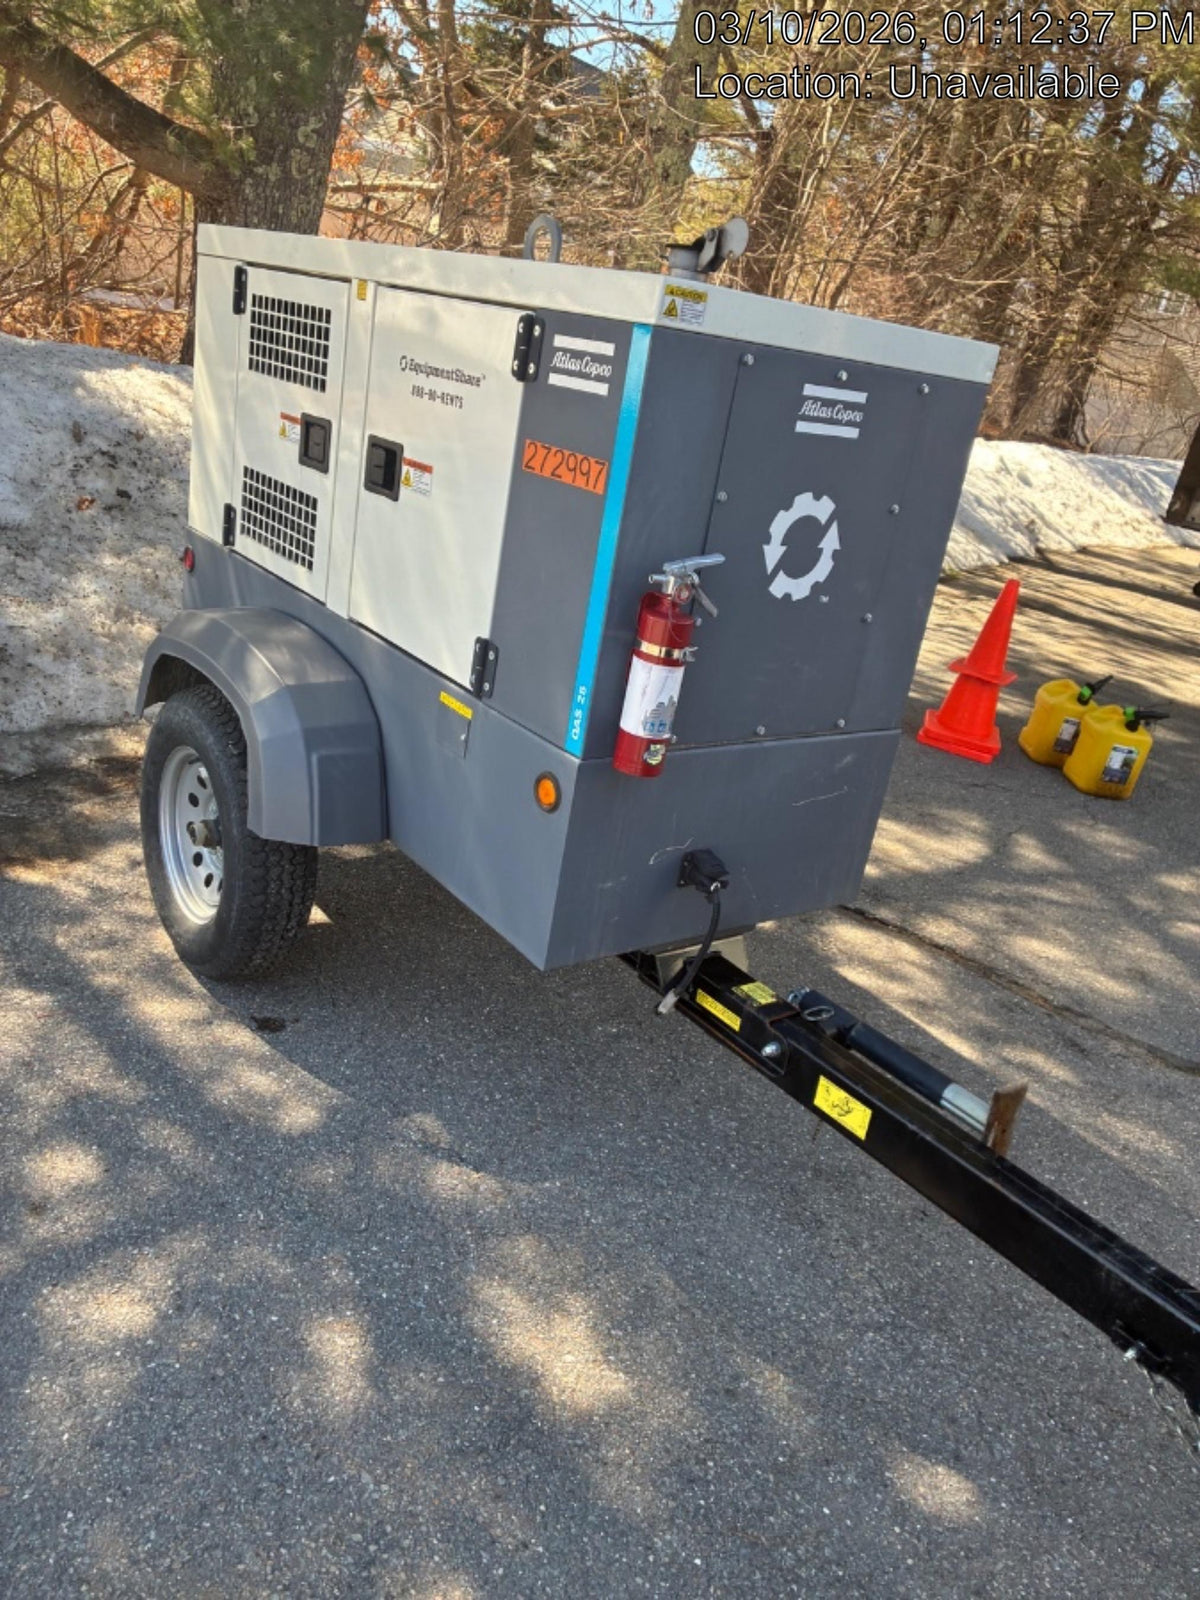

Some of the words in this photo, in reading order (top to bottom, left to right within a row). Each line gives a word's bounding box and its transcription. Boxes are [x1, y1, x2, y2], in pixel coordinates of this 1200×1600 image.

[550, 351, 581, 372] Atlas
[581, 355, 612, 377] Copco
[798, 399, 833, 418] Atlas
[833, 403, 864, 424] Copco
[524, 441, 607, 490] 272997
[571, 708, 582, 740] QAS
